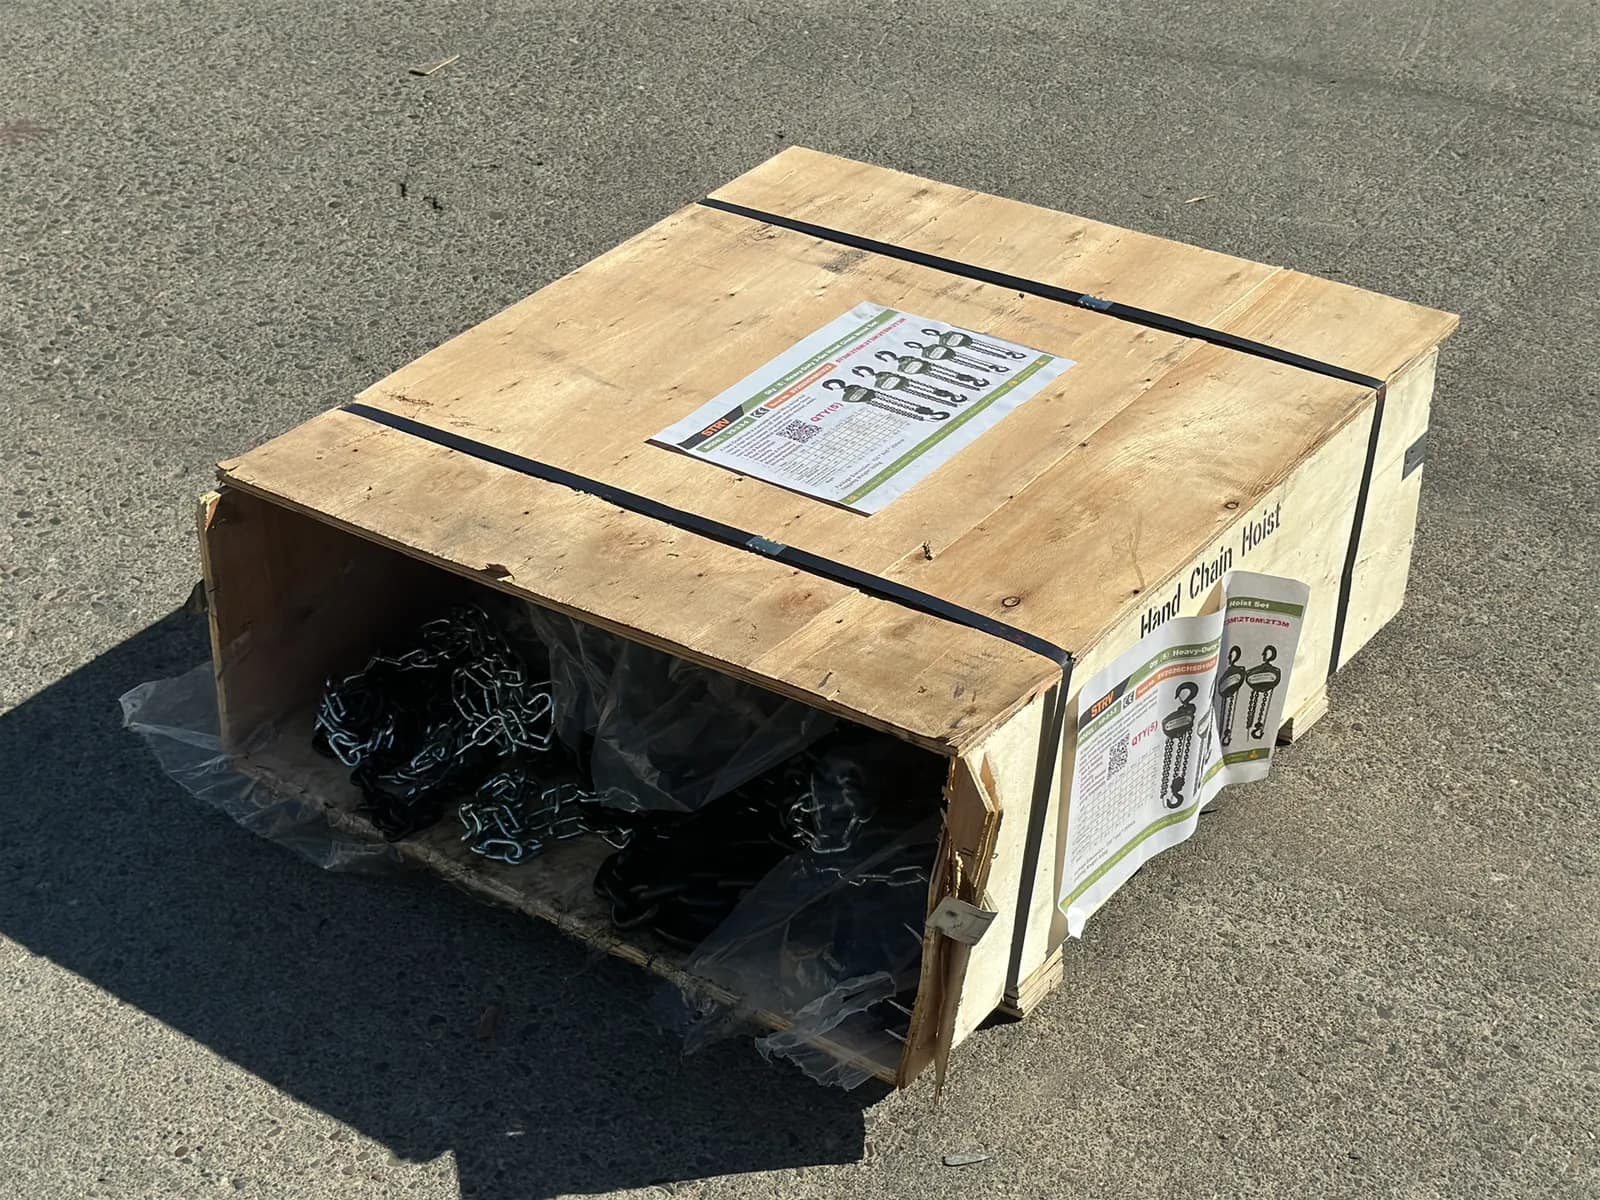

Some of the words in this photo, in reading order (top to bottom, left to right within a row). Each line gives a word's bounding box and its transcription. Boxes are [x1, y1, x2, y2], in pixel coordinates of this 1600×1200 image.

[1140, 582, 1181, 639] Hand
[1189, 546, 1233, 600] Chain
[1241, 501, 1282, 558] Hoist
[1091, 691, 1115, 719] STRV
